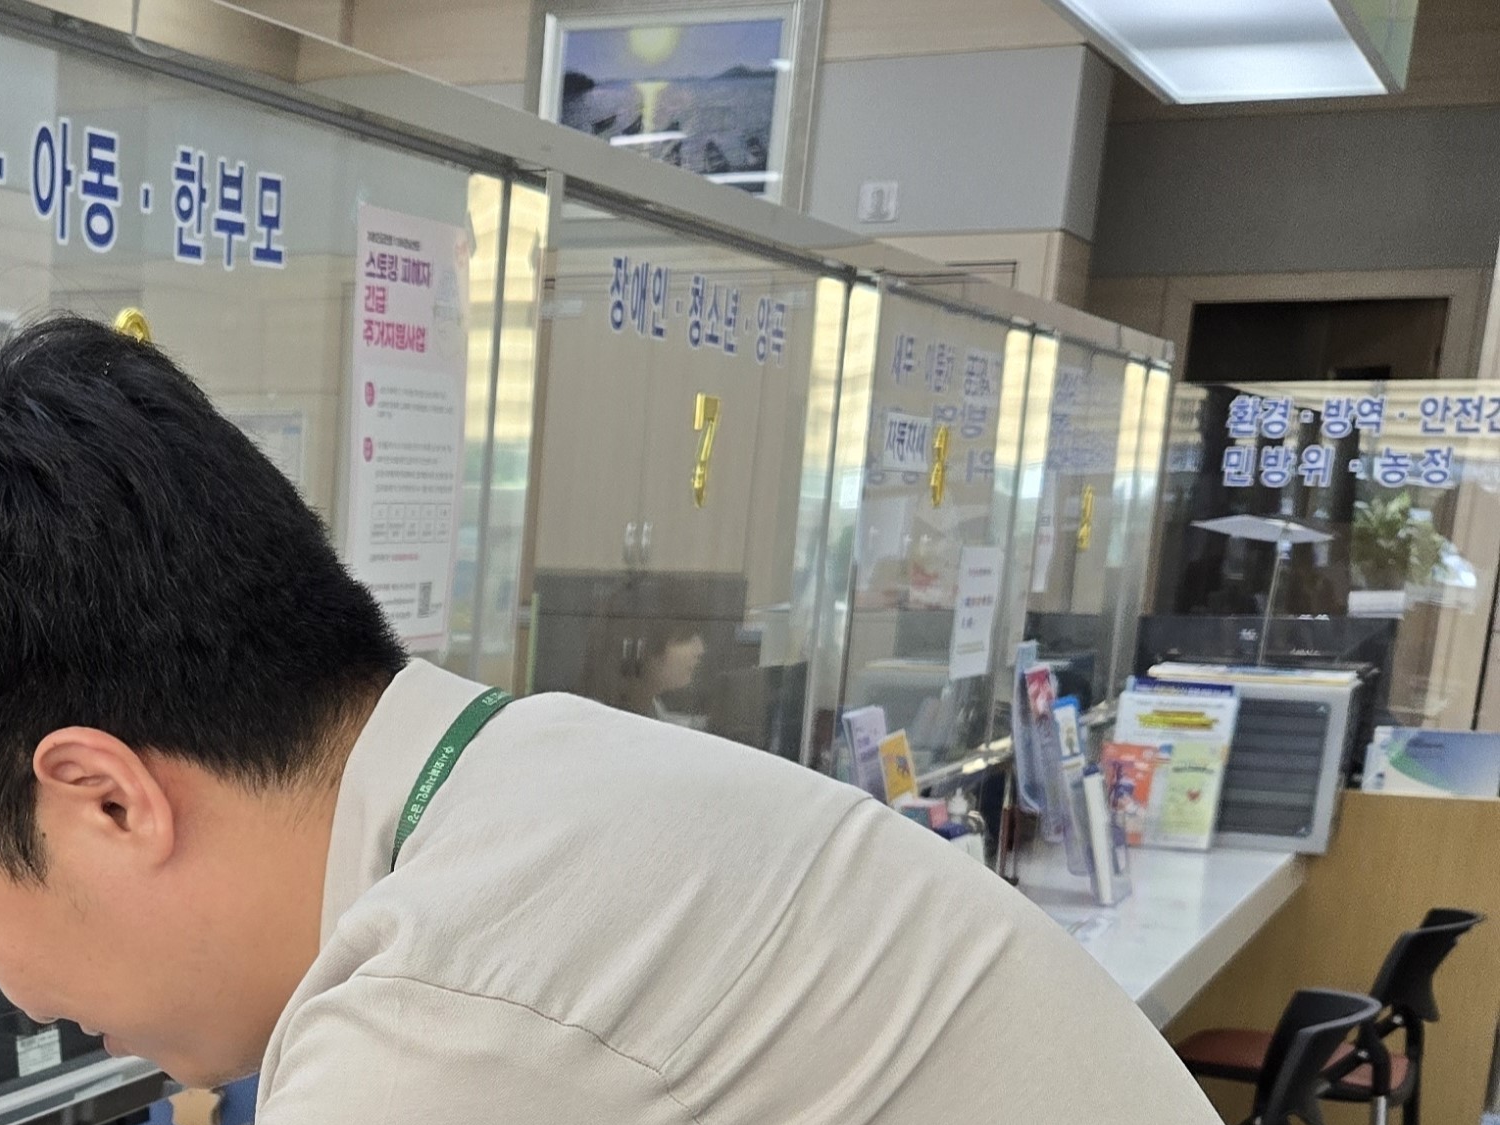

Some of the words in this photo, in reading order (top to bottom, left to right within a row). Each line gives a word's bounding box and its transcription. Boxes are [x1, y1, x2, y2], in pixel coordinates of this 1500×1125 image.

[31, 119, 121, 252] 아동
[173, 148, 286, 268] 한부모
[364, 250, 398, 282] 스토킹
[401, 257, 431, 288] 피해자
[364, 285, 386, 314] 긴급
[610, 256, 668, 339] 장애인
[689, 275, 739, 353] 청소년
[756, 297, 786, 367] 양곡
[363, 319, 426, 354] 주거지원사업
[1226, 395, 1292, 438] 환경
[1320, 394, 1387, 437] 방역
[1223, 444, 1335, 488] 민방위
[1377, 446, 1454, 487] 농정
